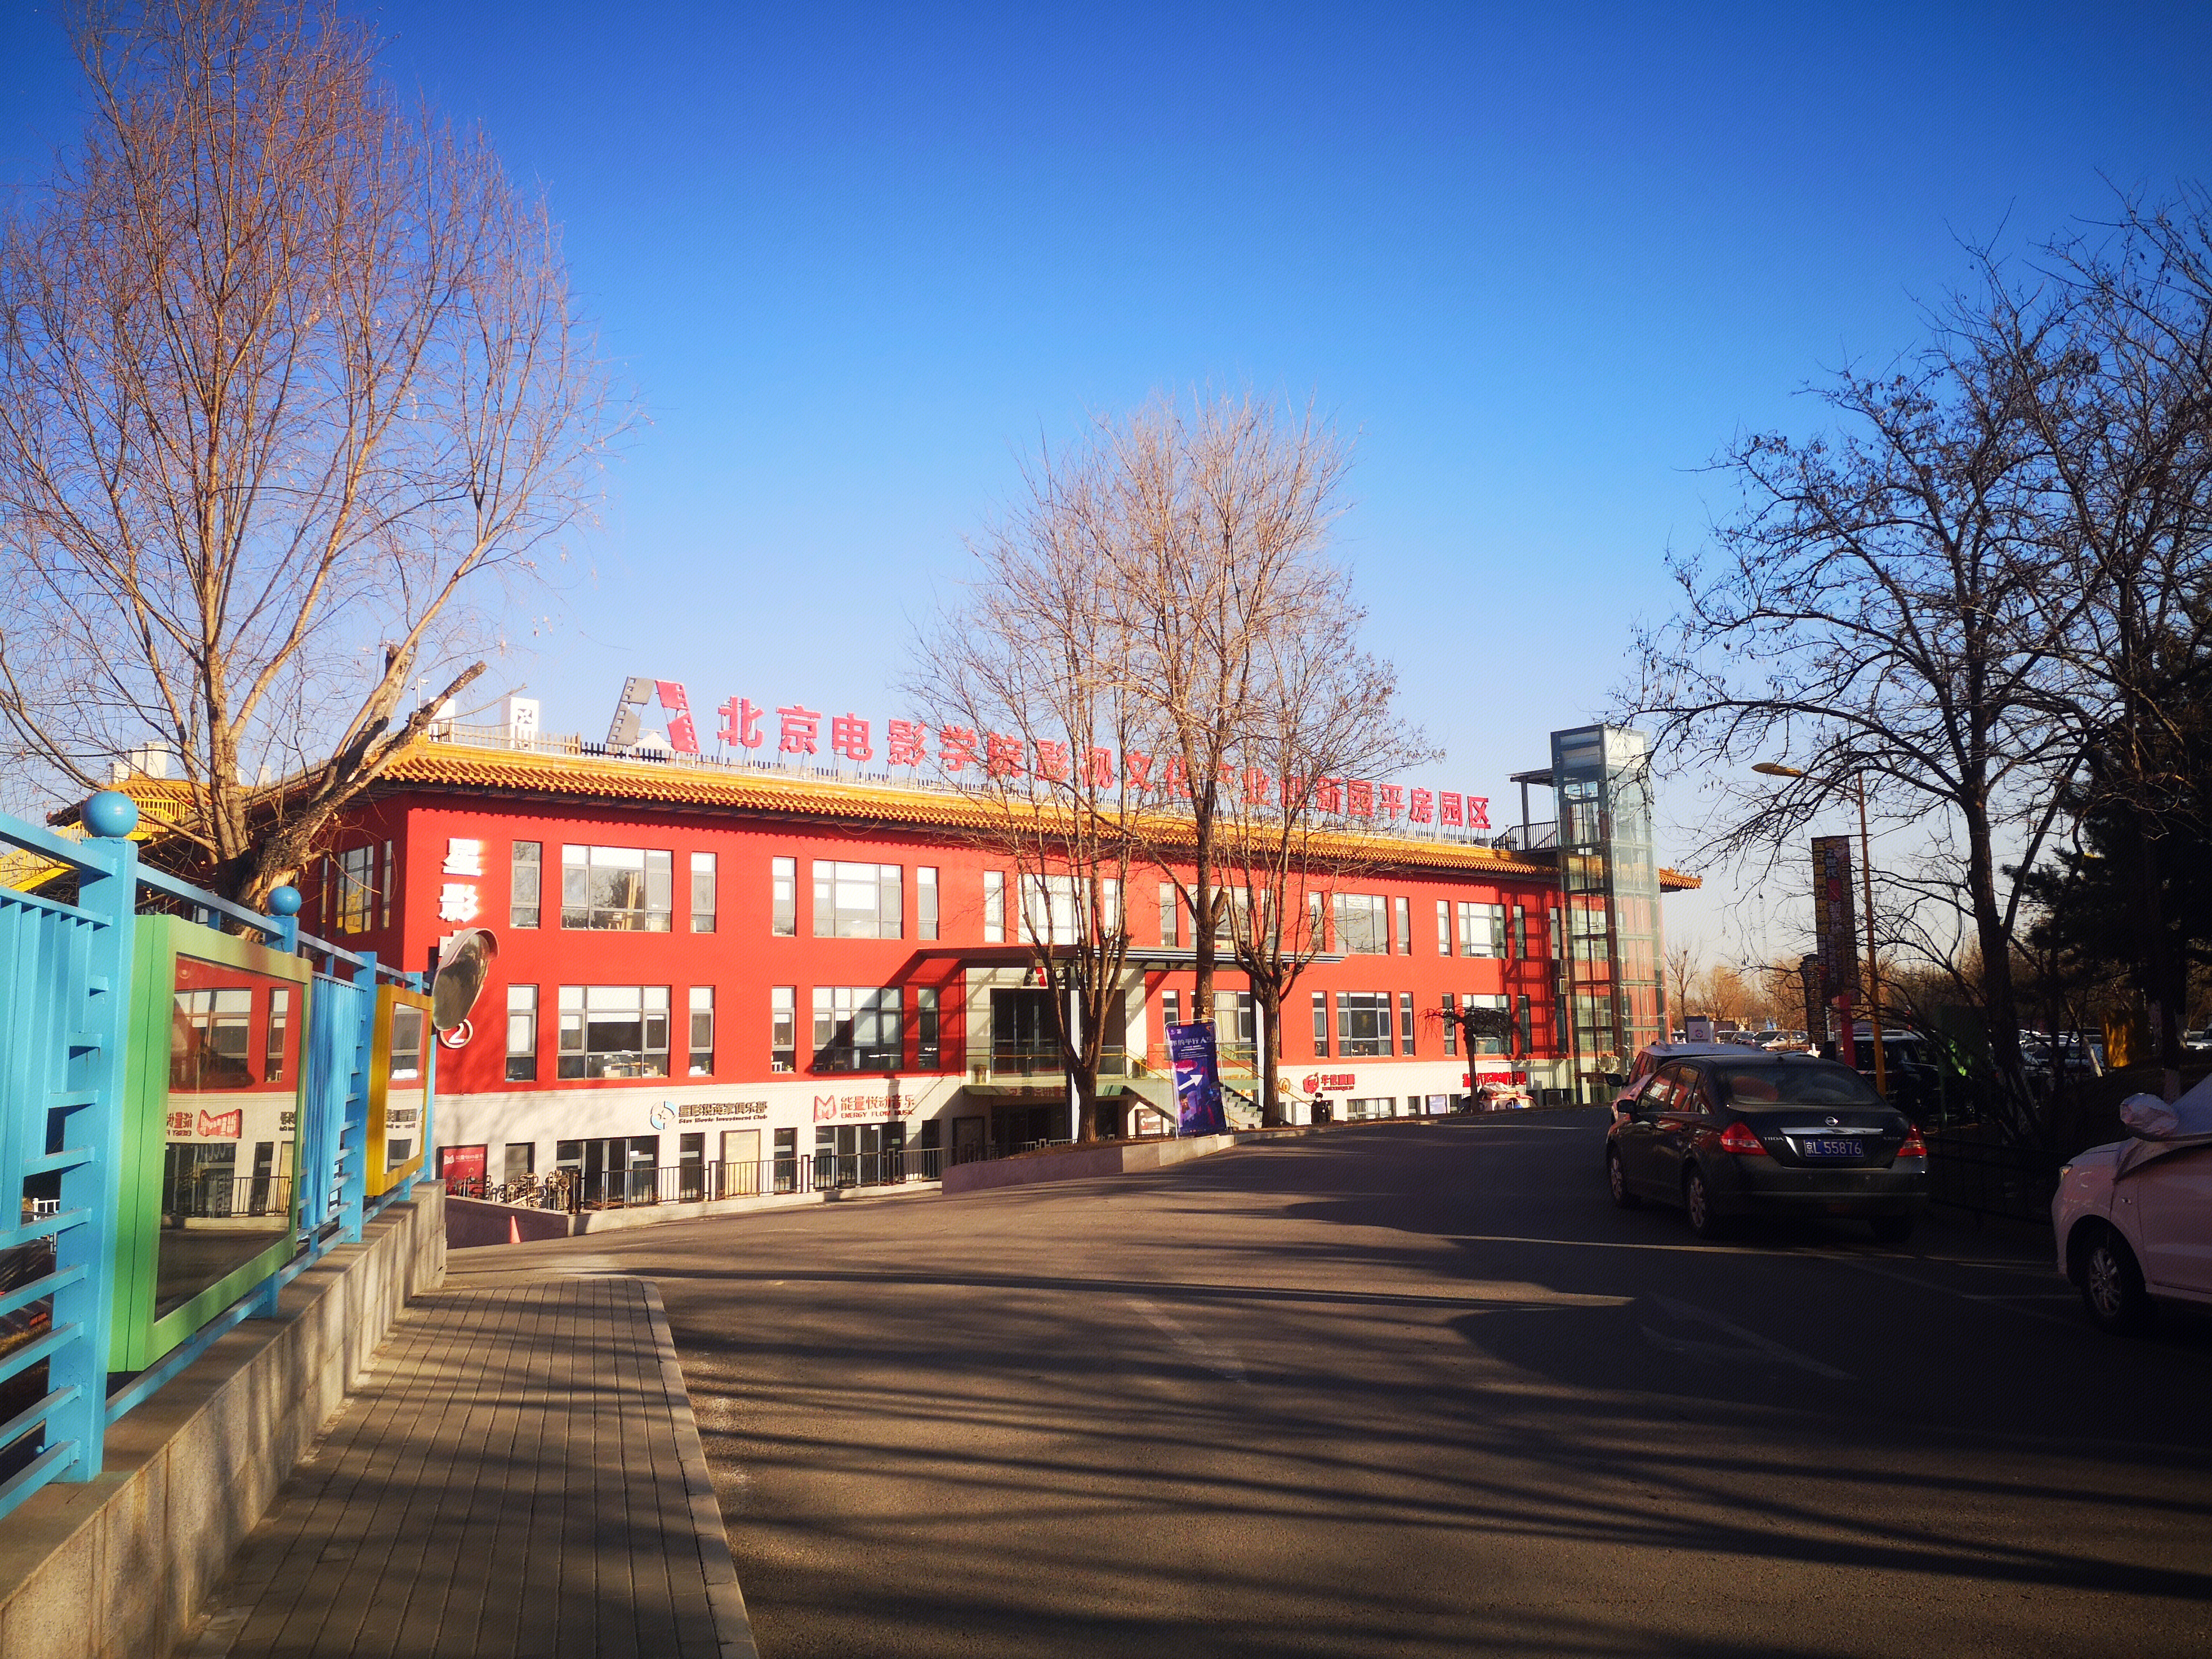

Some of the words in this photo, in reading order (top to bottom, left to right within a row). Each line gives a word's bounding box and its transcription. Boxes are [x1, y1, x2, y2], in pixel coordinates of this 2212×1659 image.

[841, 1094, 915, 1110] 能量悦动音乐
